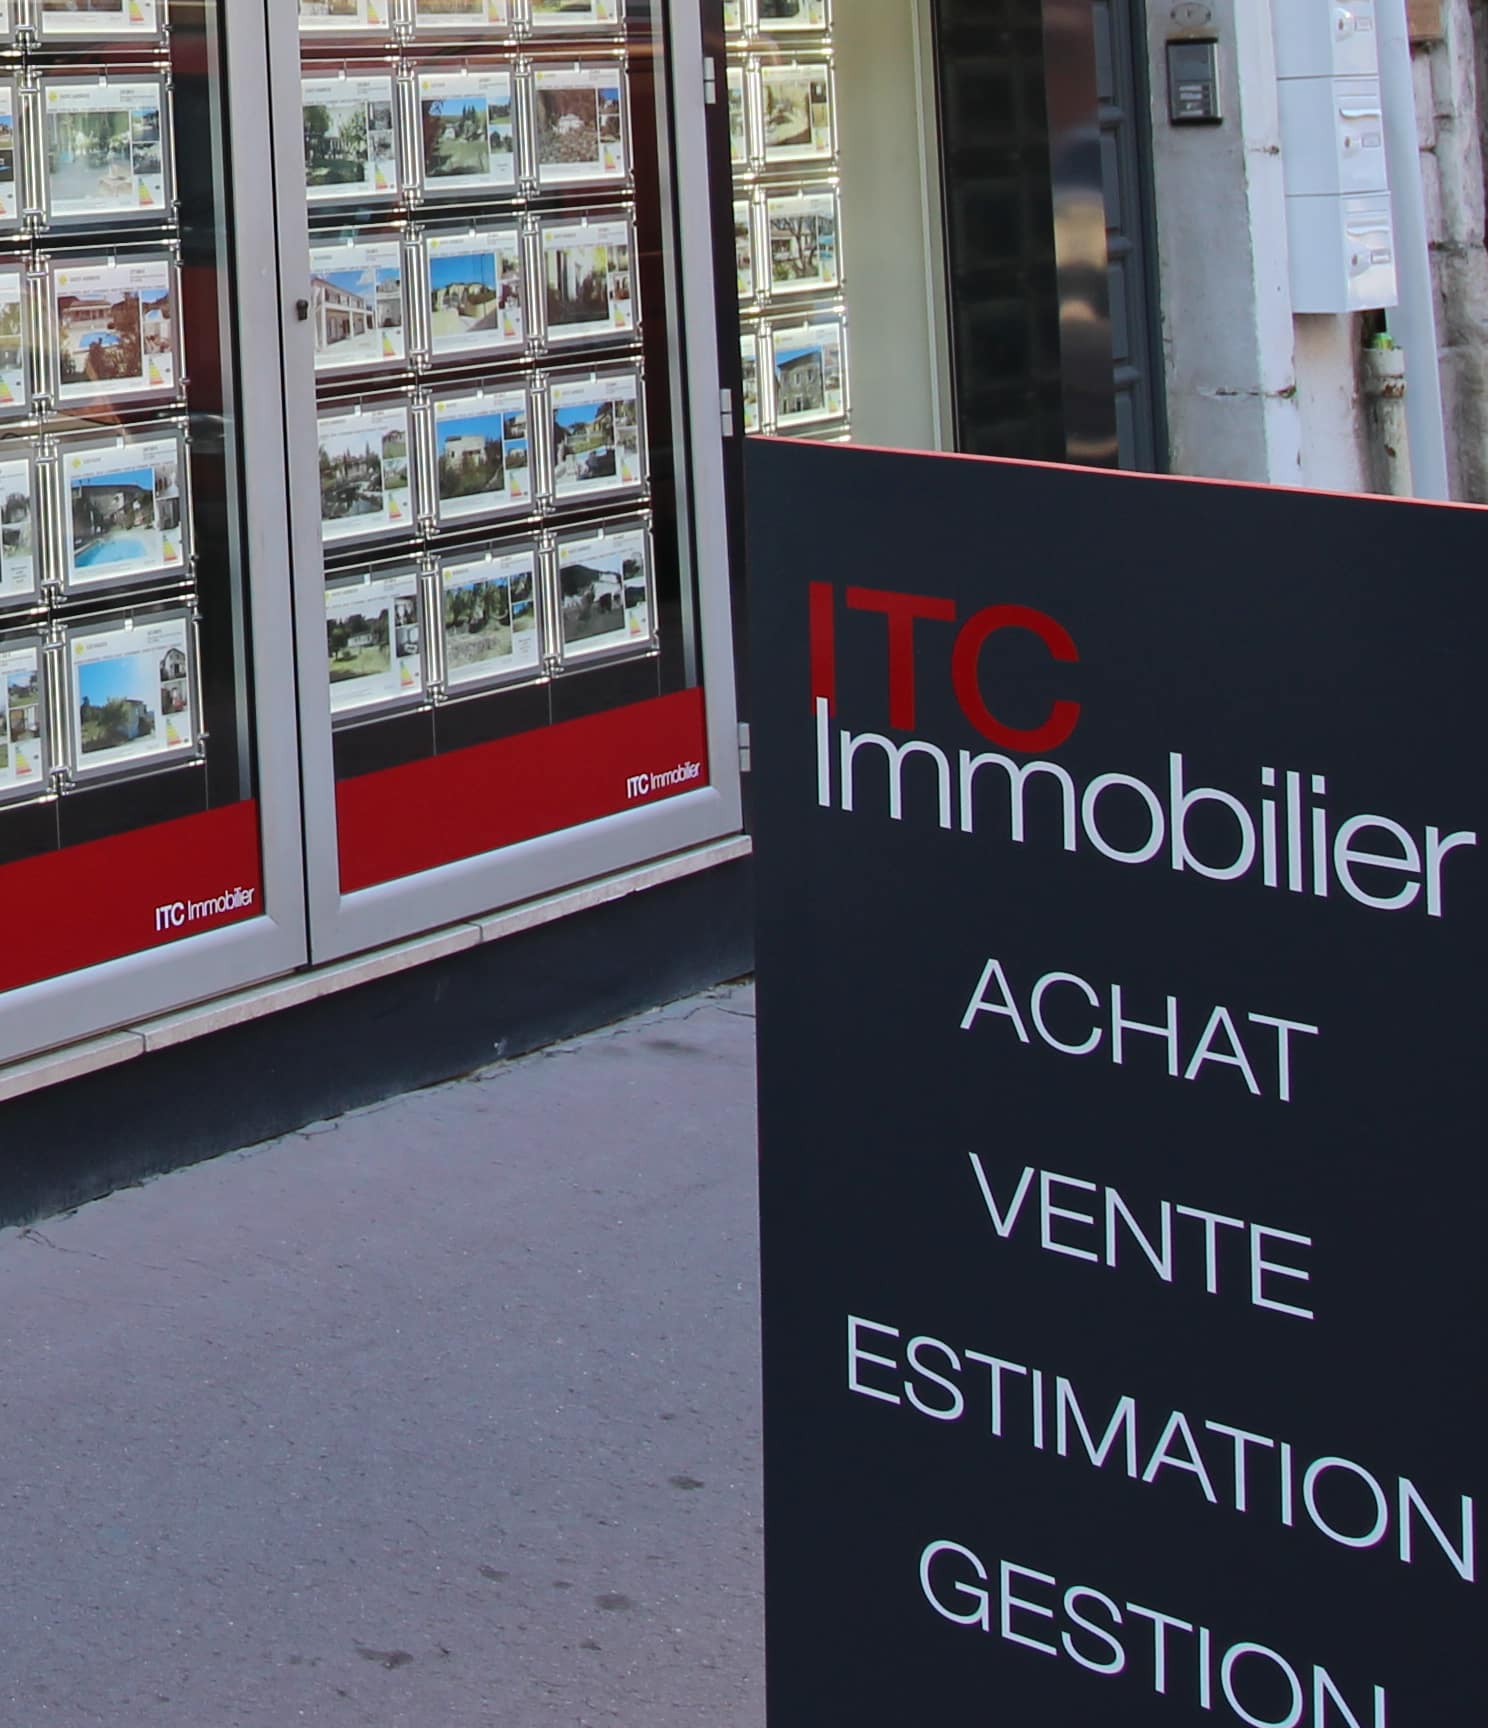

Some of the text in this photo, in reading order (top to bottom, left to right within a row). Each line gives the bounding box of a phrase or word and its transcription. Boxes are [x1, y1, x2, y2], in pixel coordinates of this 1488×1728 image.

[809, 582, 1081, 754] ITC
[626, 761, 701, 799] ITC Immobilier
[815, 696, 1477, 918] Immobilier
[155, 886, 255, 932] ITC Immobilier
[959, 957, 1320, 1103] ACHAT
[968, 1152, 1315, 1321] VENTE
[846, 1314, 1475, 1583] ESTIMATION
[918, 1539, 1387, 1728] GESTION
